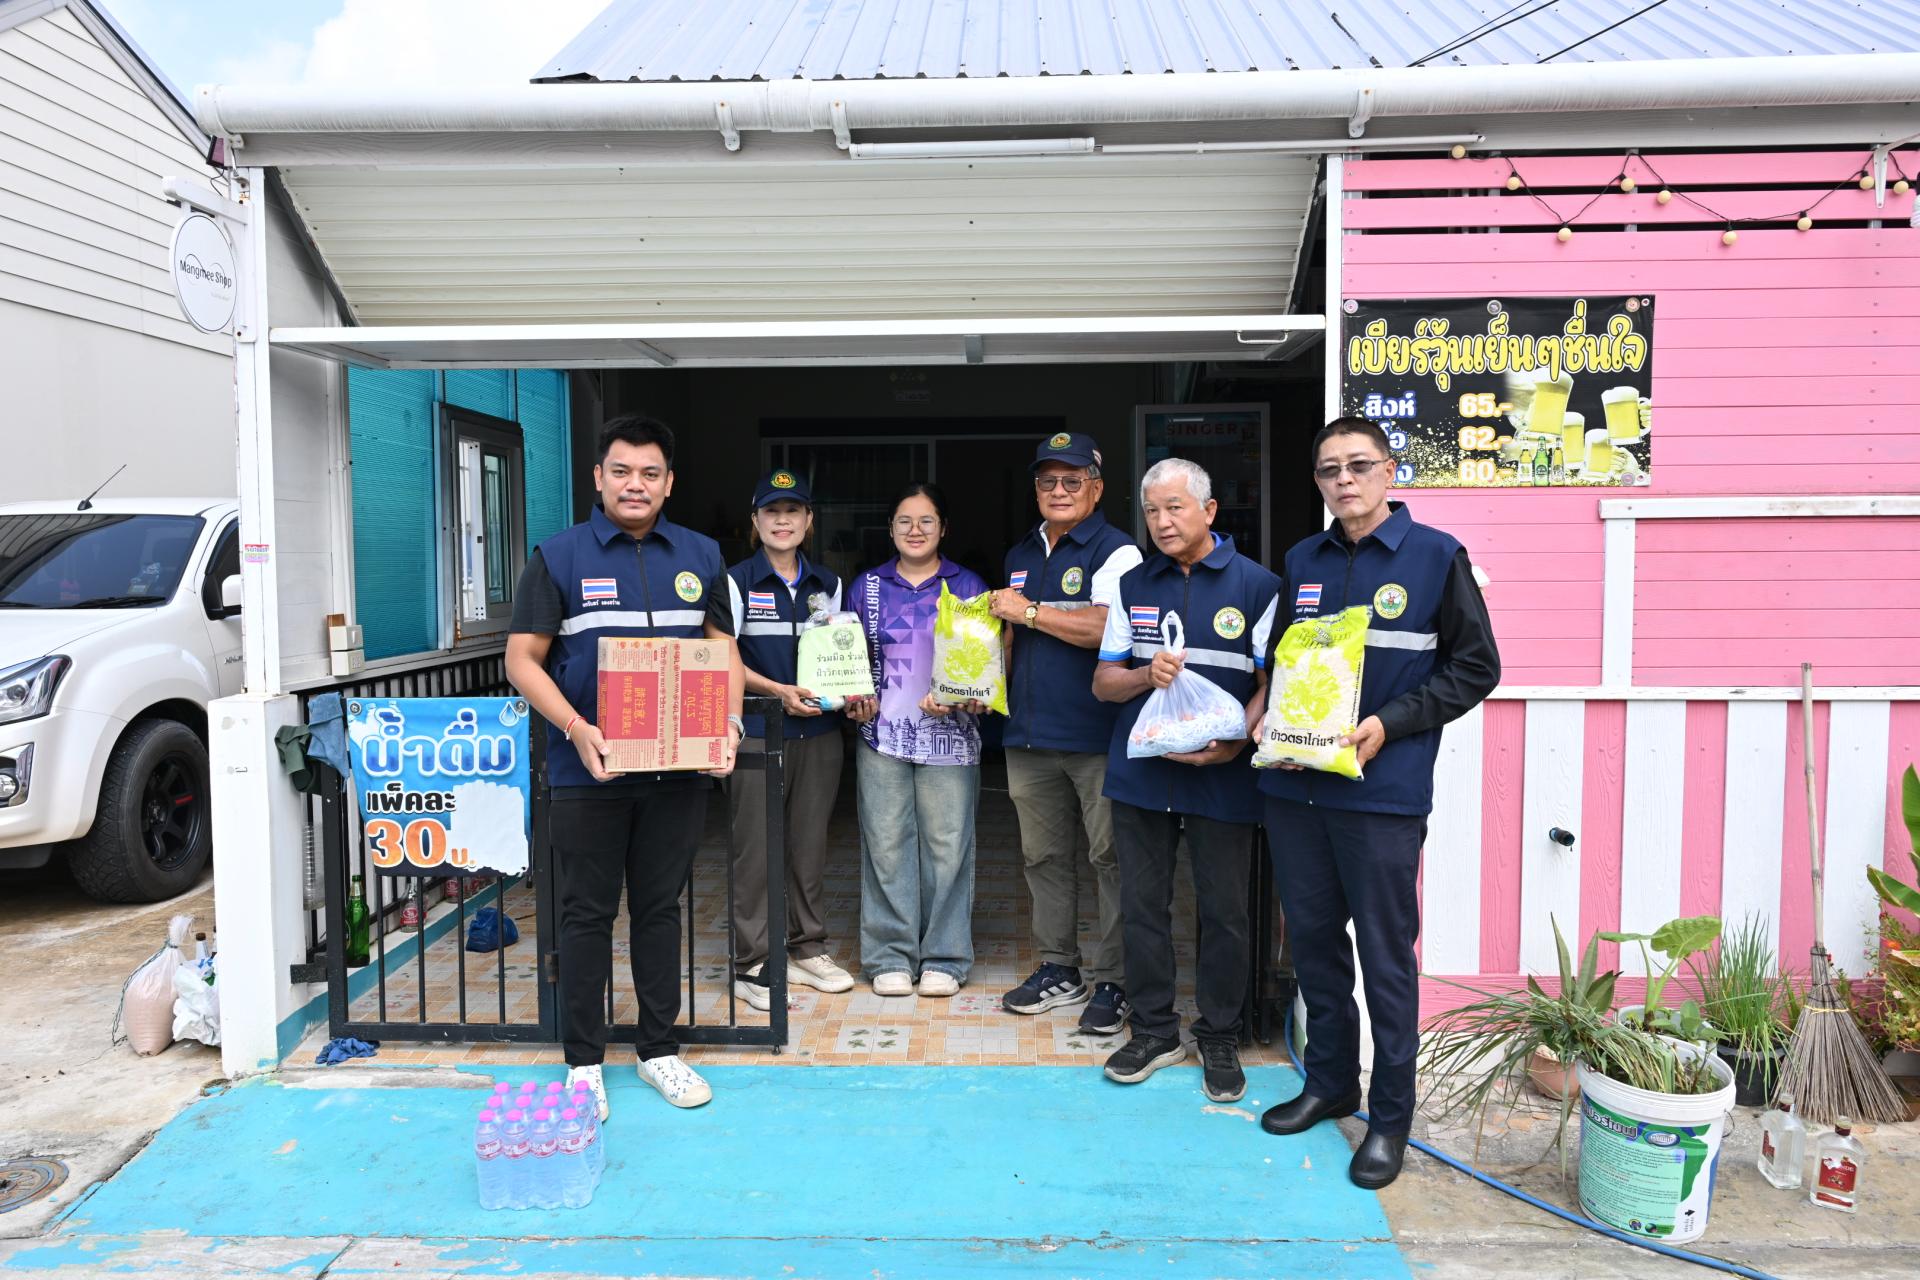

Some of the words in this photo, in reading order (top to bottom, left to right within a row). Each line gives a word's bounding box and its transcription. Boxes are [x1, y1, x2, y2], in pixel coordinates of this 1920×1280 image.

[215, 271, 232, 288] Shop
[1364, 392, 1417, 418] สิงห์
[1458, 393, 1514, 418] 65.-
[1167, 423, 1238, 436] SINGER
[1458, 425, 1514, 451] 62.-
[362, 708, 516, 776] น้ำดื่ม
[1270, 727, 1336, 747] ข้าวตราไก่แจ้
[366, 781, 457, 814] แพ็คละ
[366, 818, 447, 868] 30
